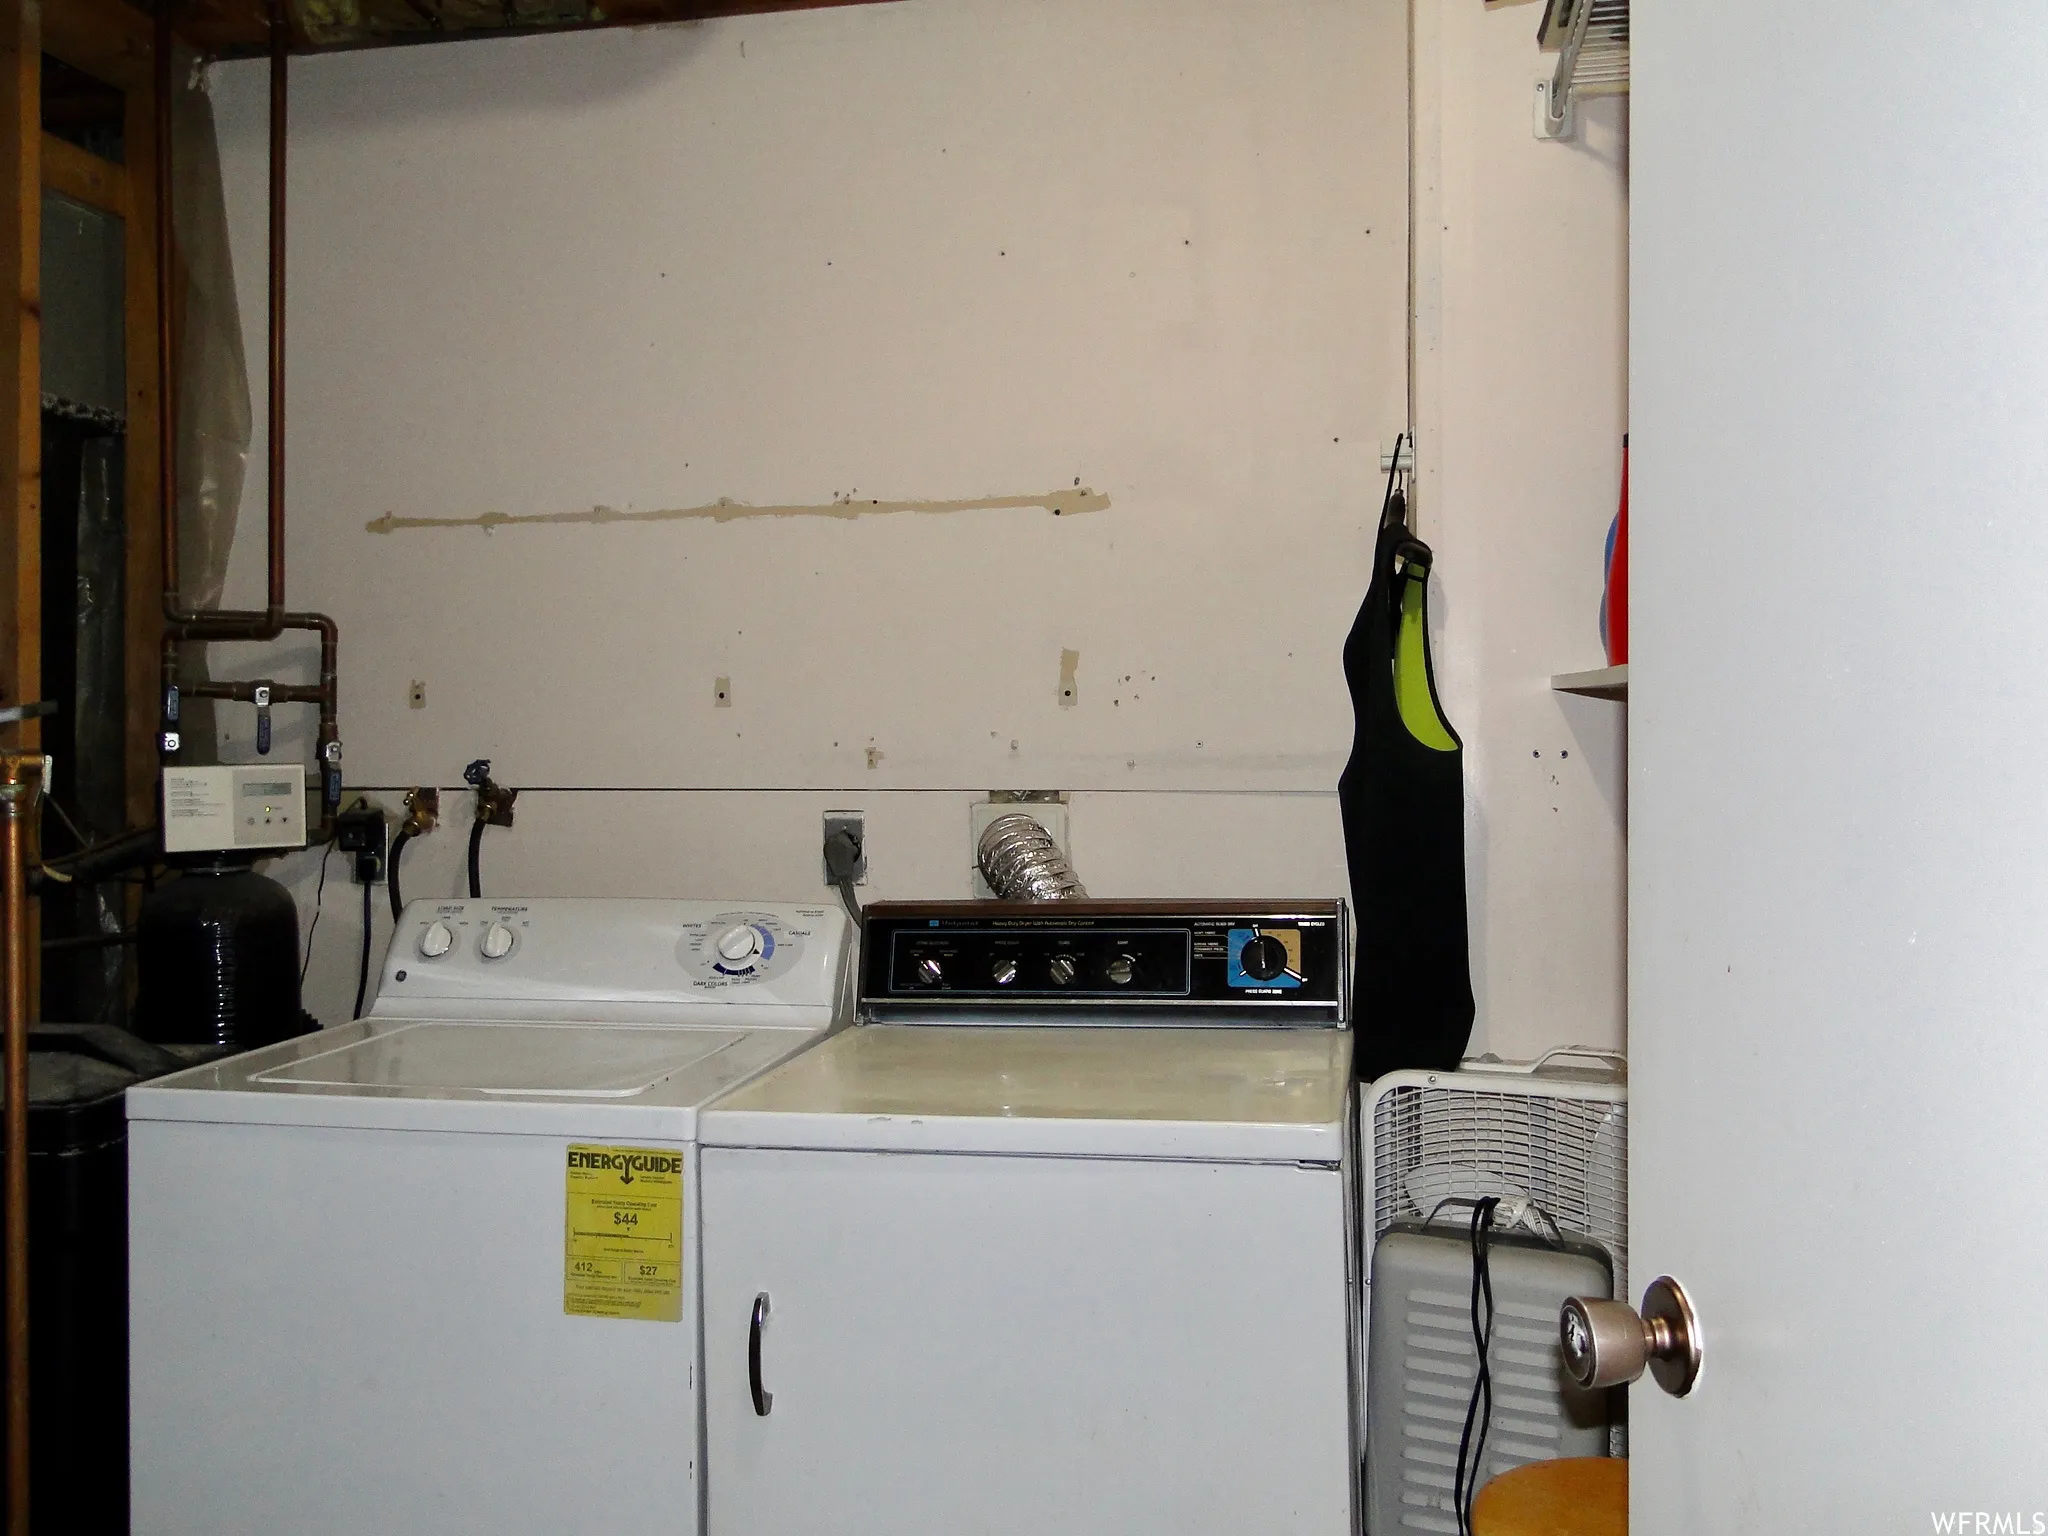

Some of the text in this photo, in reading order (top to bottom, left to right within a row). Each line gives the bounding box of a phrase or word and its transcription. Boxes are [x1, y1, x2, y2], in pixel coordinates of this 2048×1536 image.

[568, 1151, 683, 1174] ENERGYGUIDE
[613, 1211, 639, 1226] $44
[574, 1261, 594, 1272] 412
[639, 1264, 658, 1276] $27
